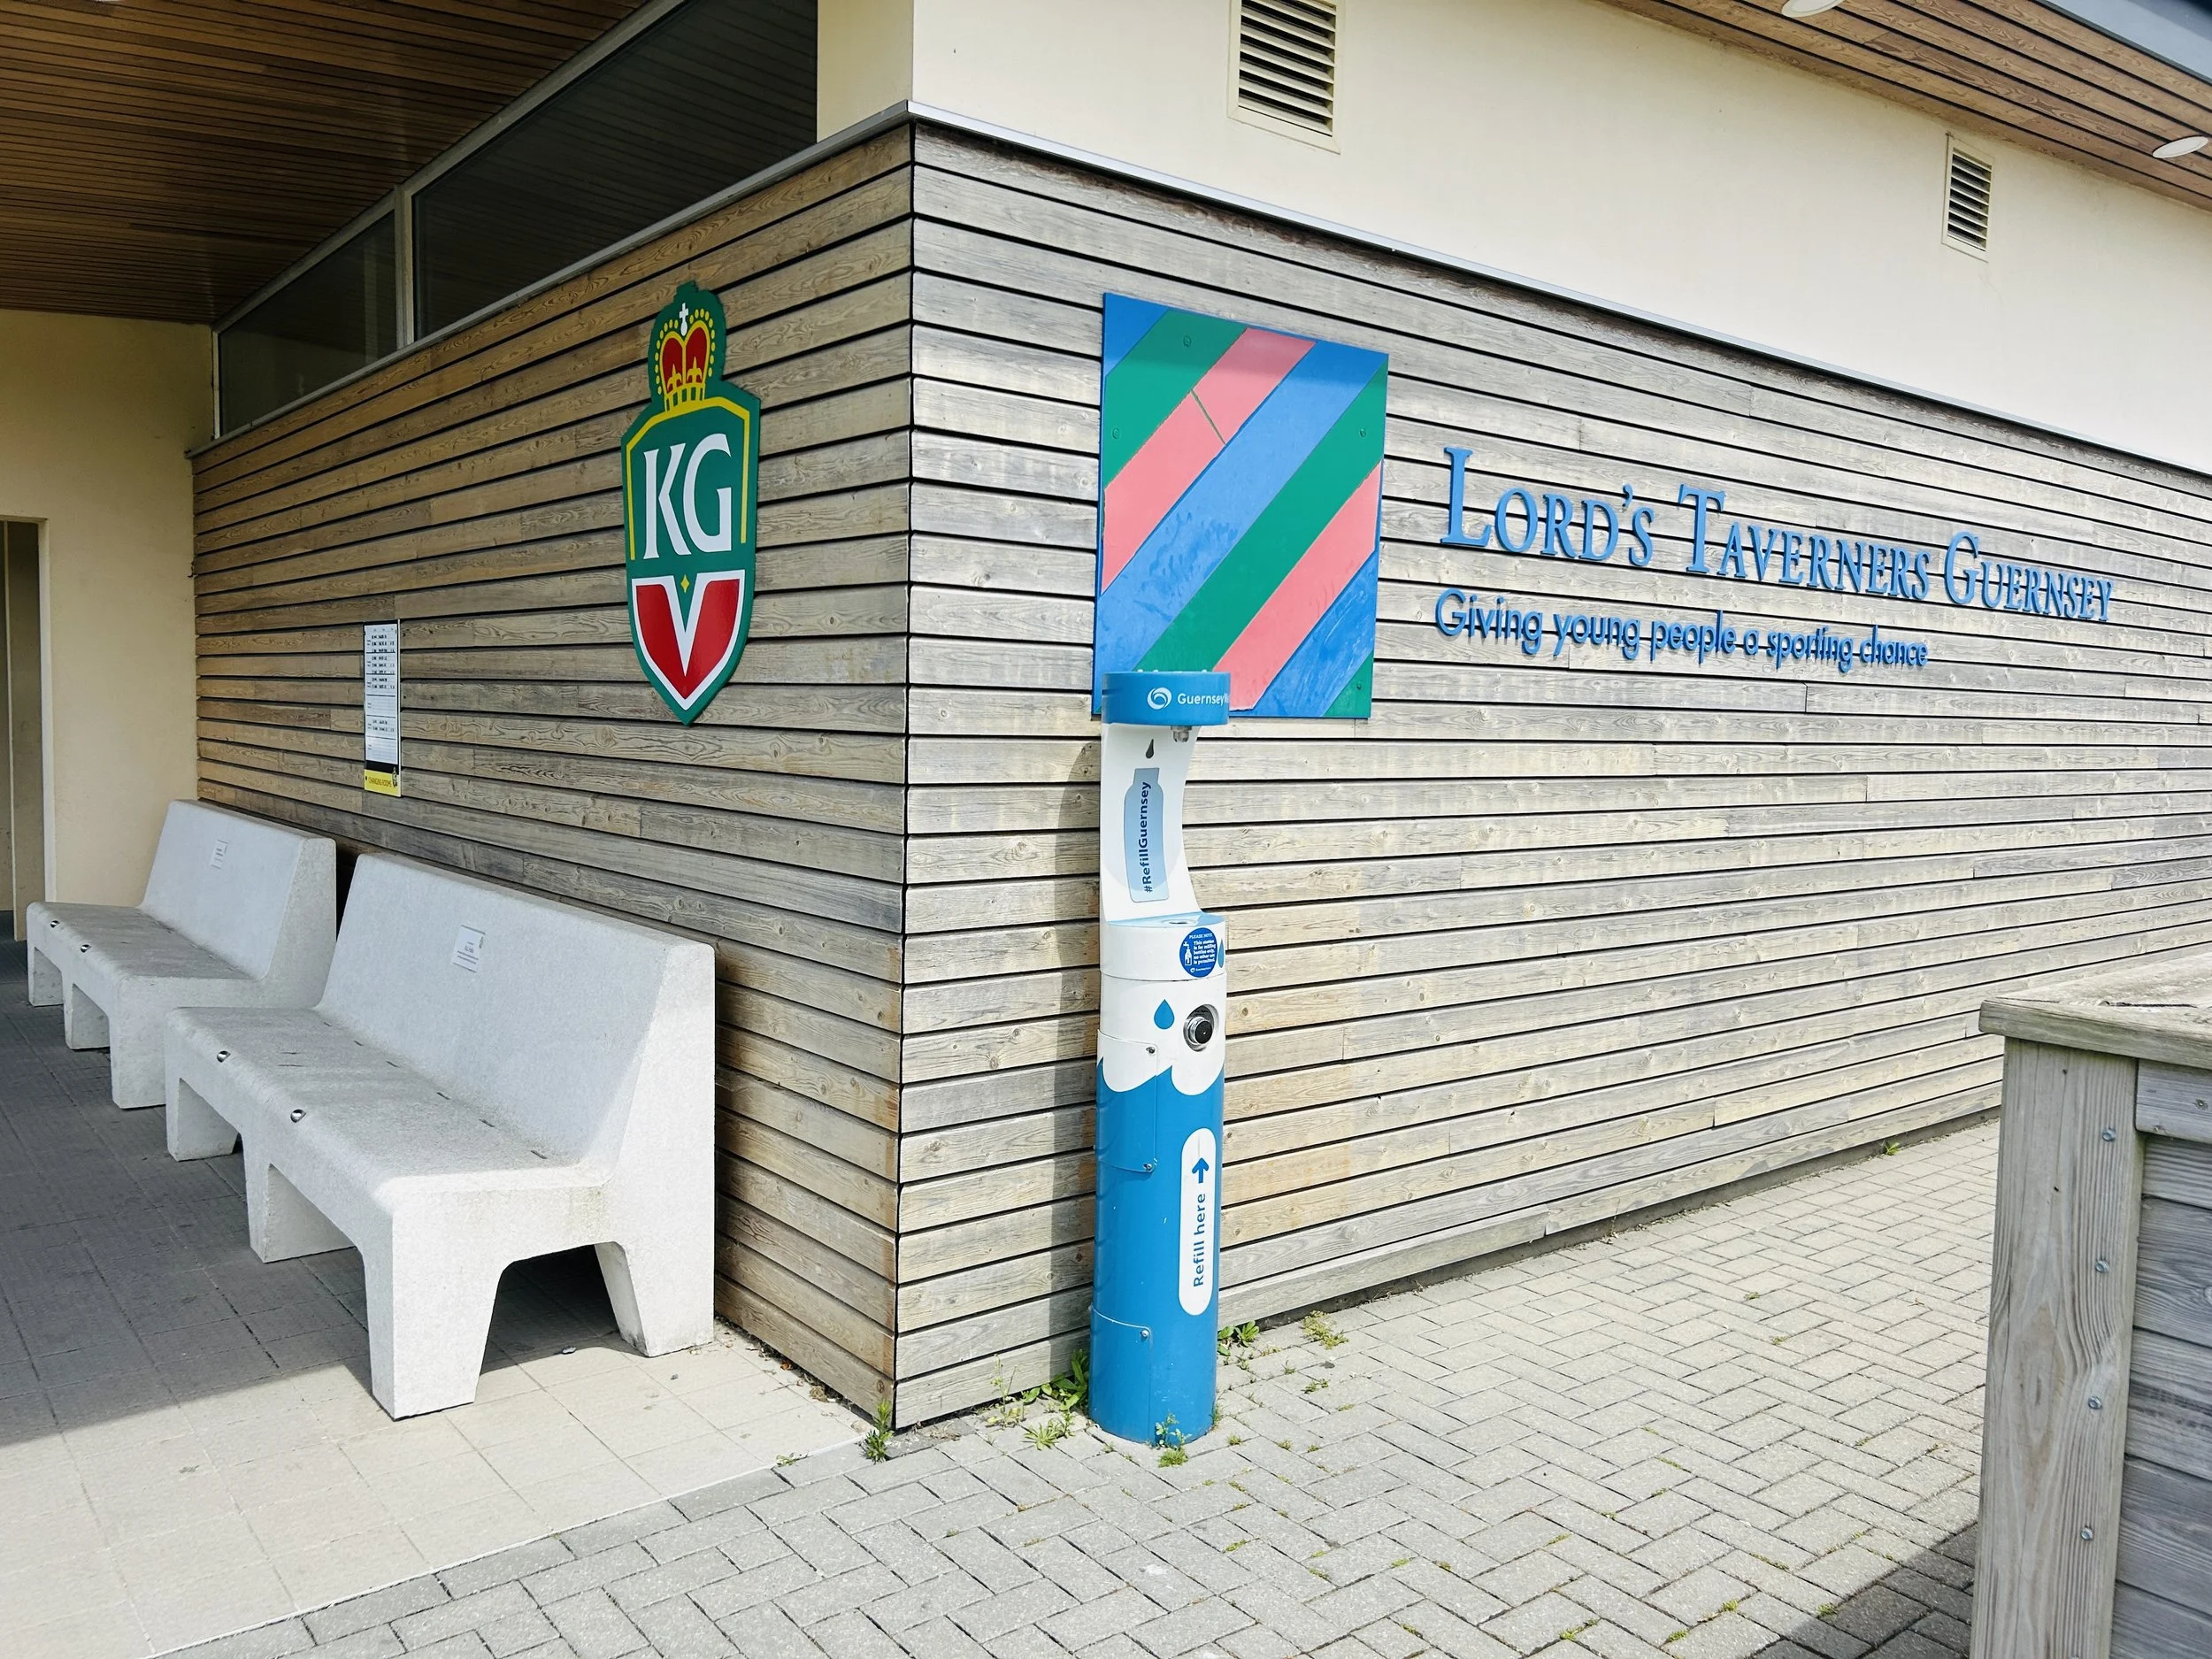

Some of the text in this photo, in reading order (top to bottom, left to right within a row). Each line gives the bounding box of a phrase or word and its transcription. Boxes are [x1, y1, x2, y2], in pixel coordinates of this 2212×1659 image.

[643, 434, 731, 559] KG
[1435, 588, 1928, 674] Giving young people a sporting chance
[1139, 781, 1153, 893] #RefillGuernsey
[1193, 1193, 1206, 1287] Refill here
